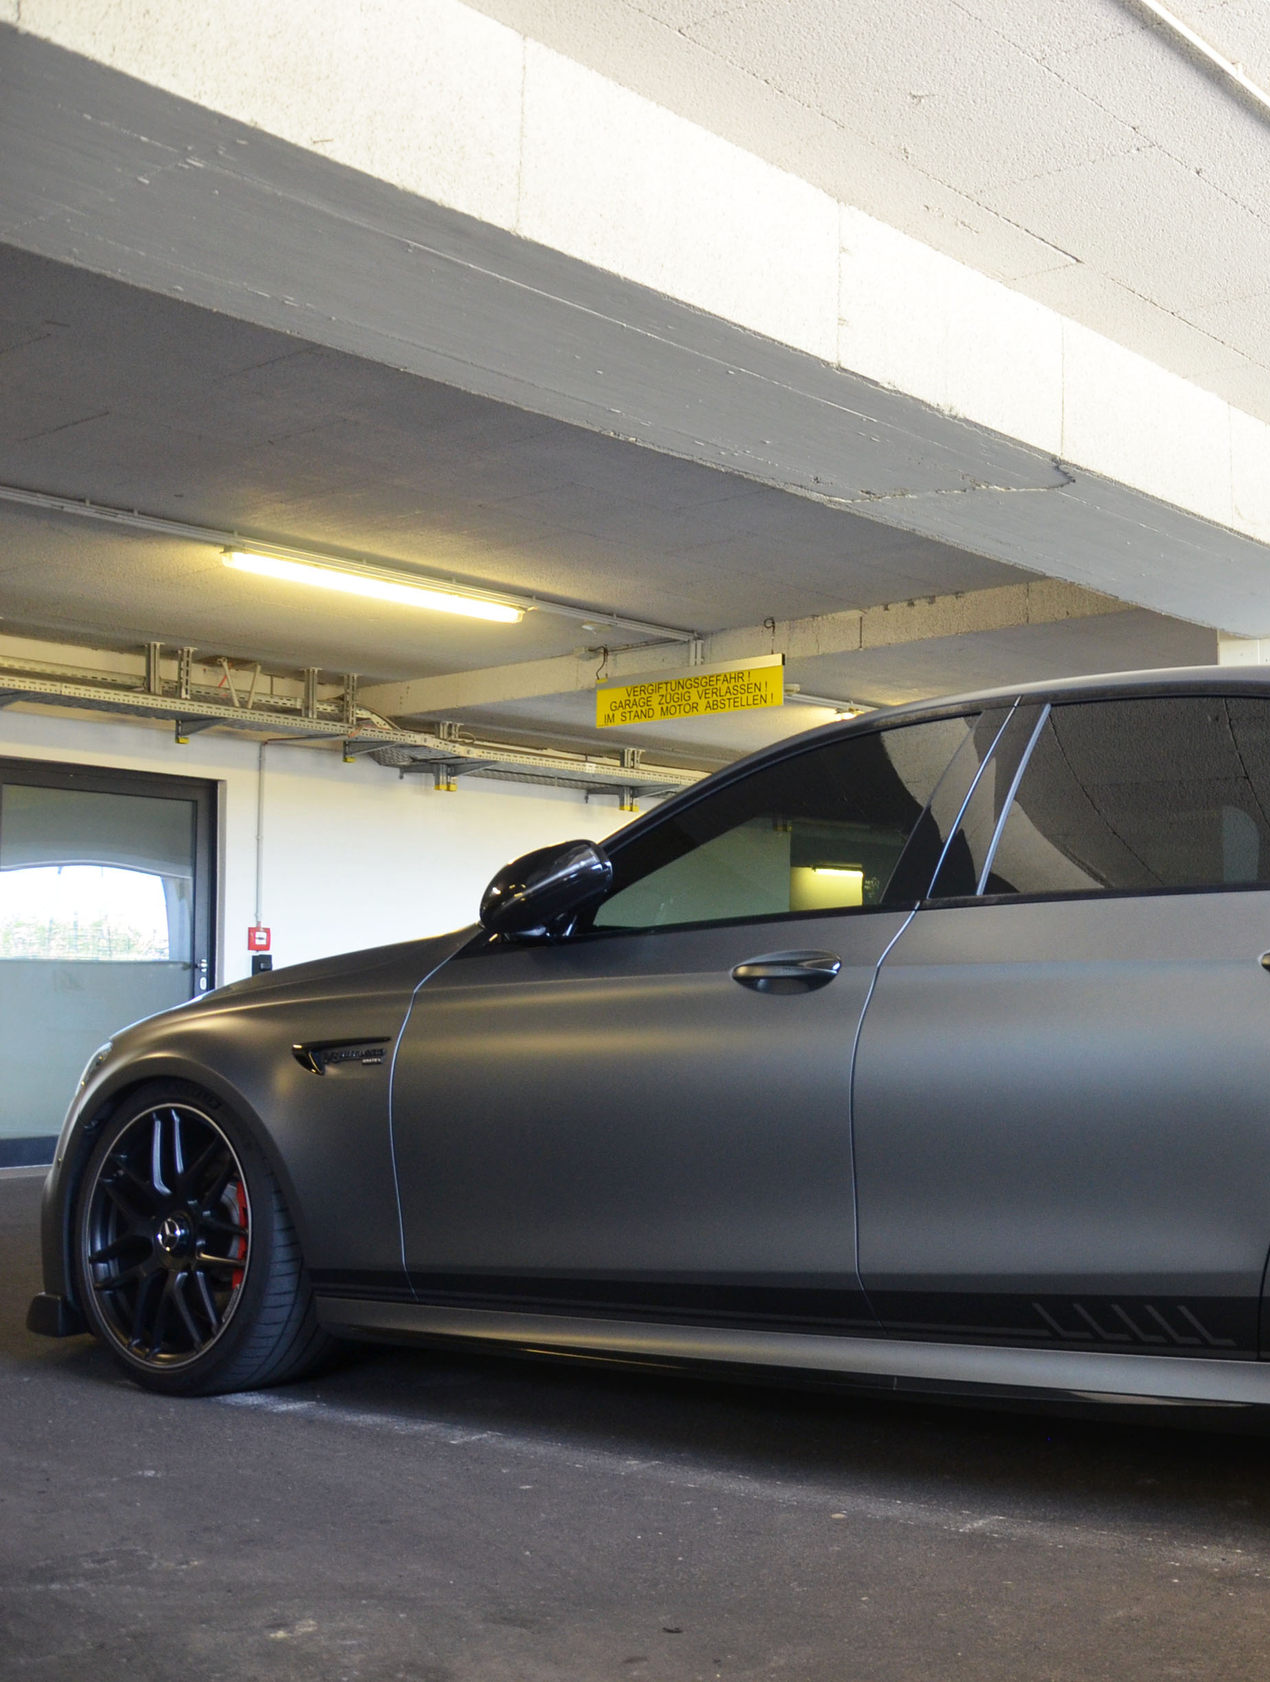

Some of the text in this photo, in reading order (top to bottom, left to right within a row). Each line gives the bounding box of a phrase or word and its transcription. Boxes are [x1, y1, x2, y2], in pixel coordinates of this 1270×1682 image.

[610, 696, 652, 712] GARAGE
[658, 690, 691, 706] ZÜGIG
[697, 683, 762, 700] VERLASSEN
[626, 672, 745, 698] VERGIFTUNGSGEFAHR
[604, 713, 615, 724] IM
[620, 708, 655, 722] STAND
[660, 701, 699, 717] MOTOR
[704, 693, 768, 712] ABSTELLEN
